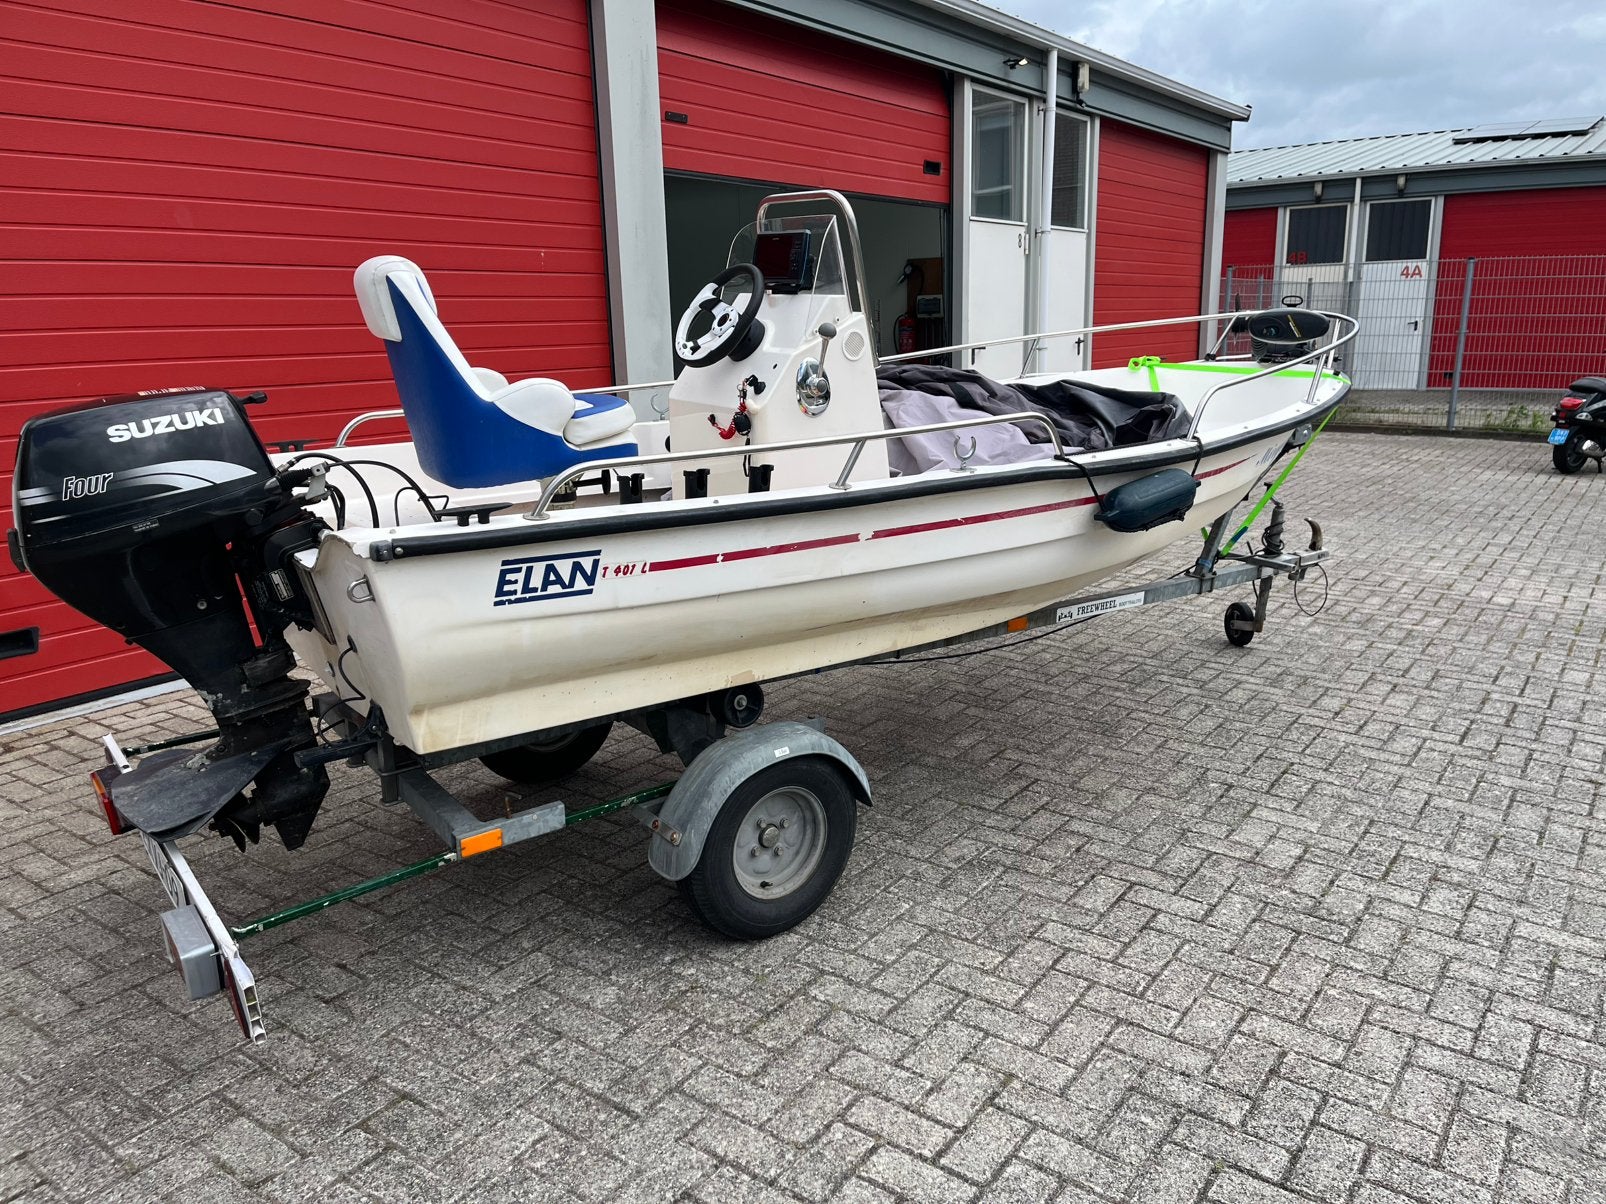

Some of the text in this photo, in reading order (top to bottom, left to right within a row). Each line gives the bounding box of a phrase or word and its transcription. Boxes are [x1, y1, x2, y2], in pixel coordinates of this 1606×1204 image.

[1400, 264, 1423, 279] 4A
[107, 407, 226, 443] SUZUKI
[62, 471, 114, 502] Four
[494, 558, 647, 599] ELAN T 401 L
[1077, 600, 1117, 616] FREEWHEEL
